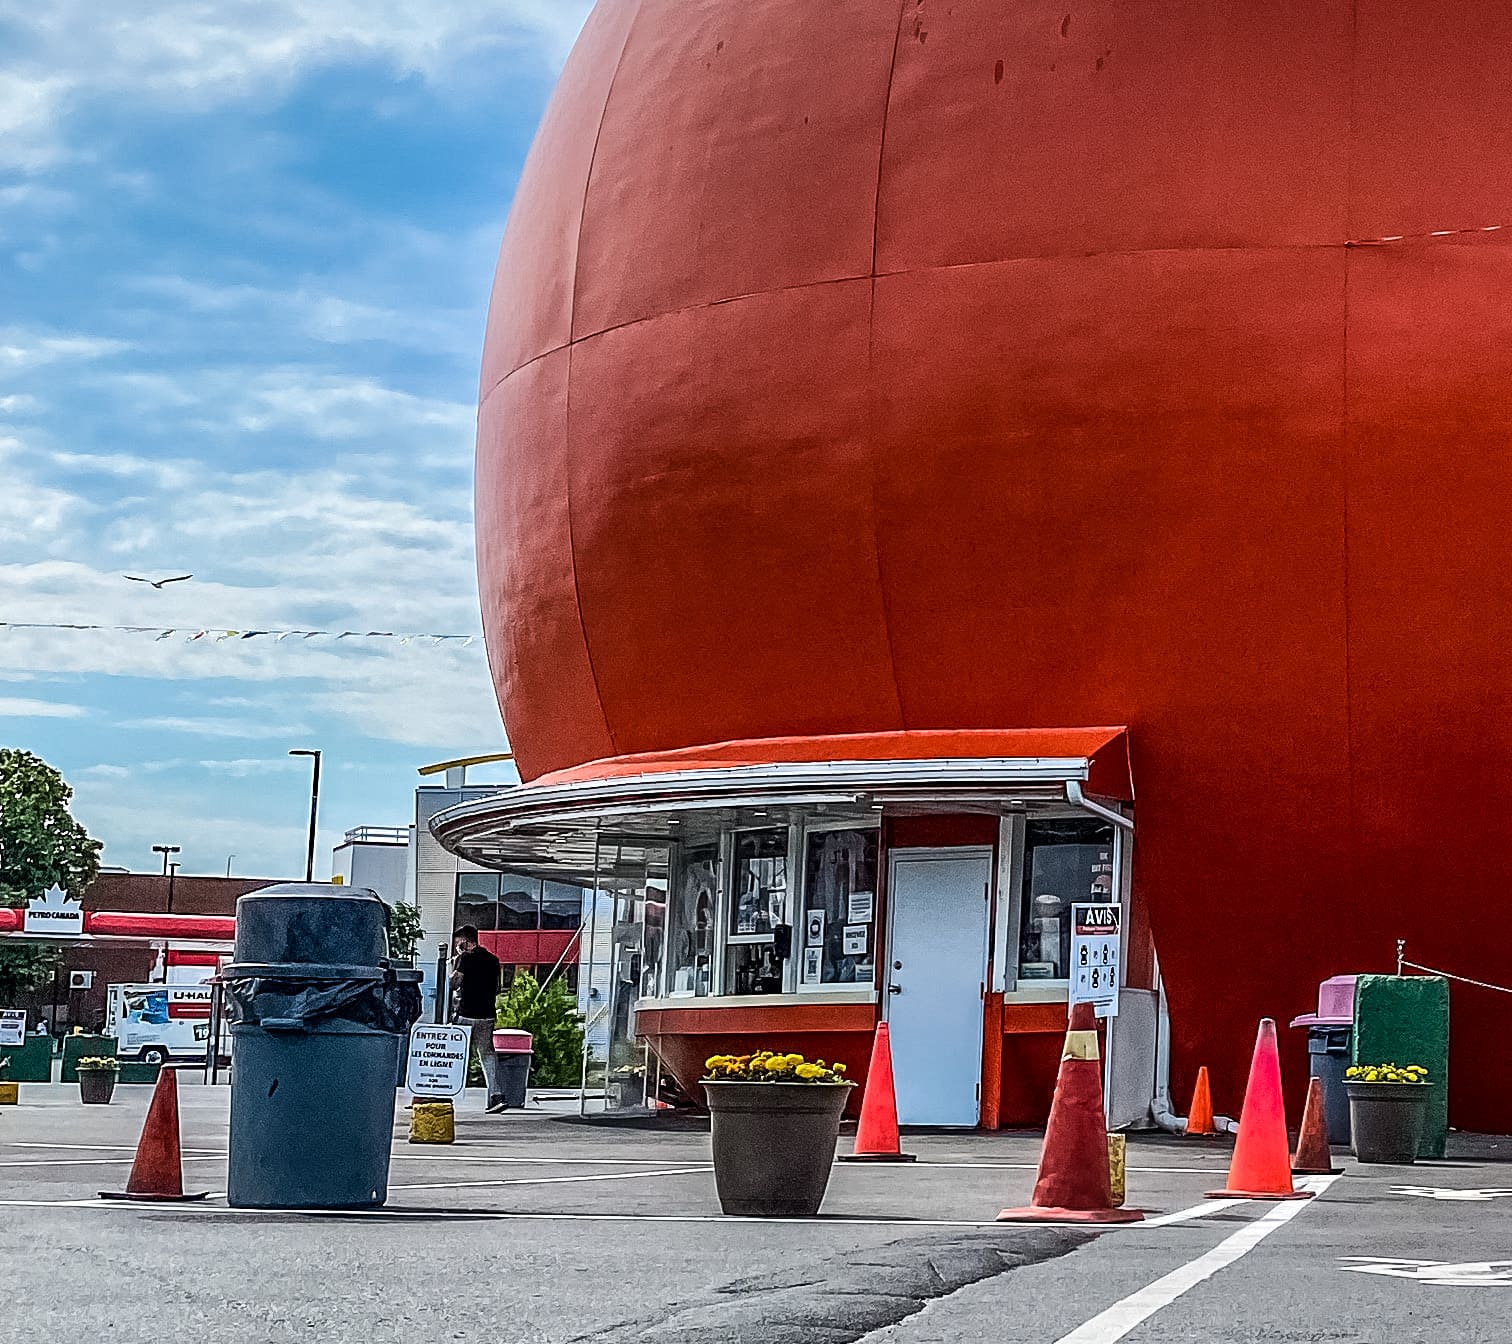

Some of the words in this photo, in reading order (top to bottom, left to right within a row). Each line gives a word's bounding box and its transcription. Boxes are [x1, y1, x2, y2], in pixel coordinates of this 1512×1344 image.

[1085, 909, 1112, 925] AVIS
[416, 1031, 448, 1041] ENTREZ
[450, 1033, 463, 1042] ICI
[425, 1042, 446, 1050] POUR
[412, 1050, 422, 1058] LES
[423, 1051, 464, 1060] COMMANDES
[419, 1059, 429, 1067] EN
[430, 1060, 454, 1068] LIGNE
